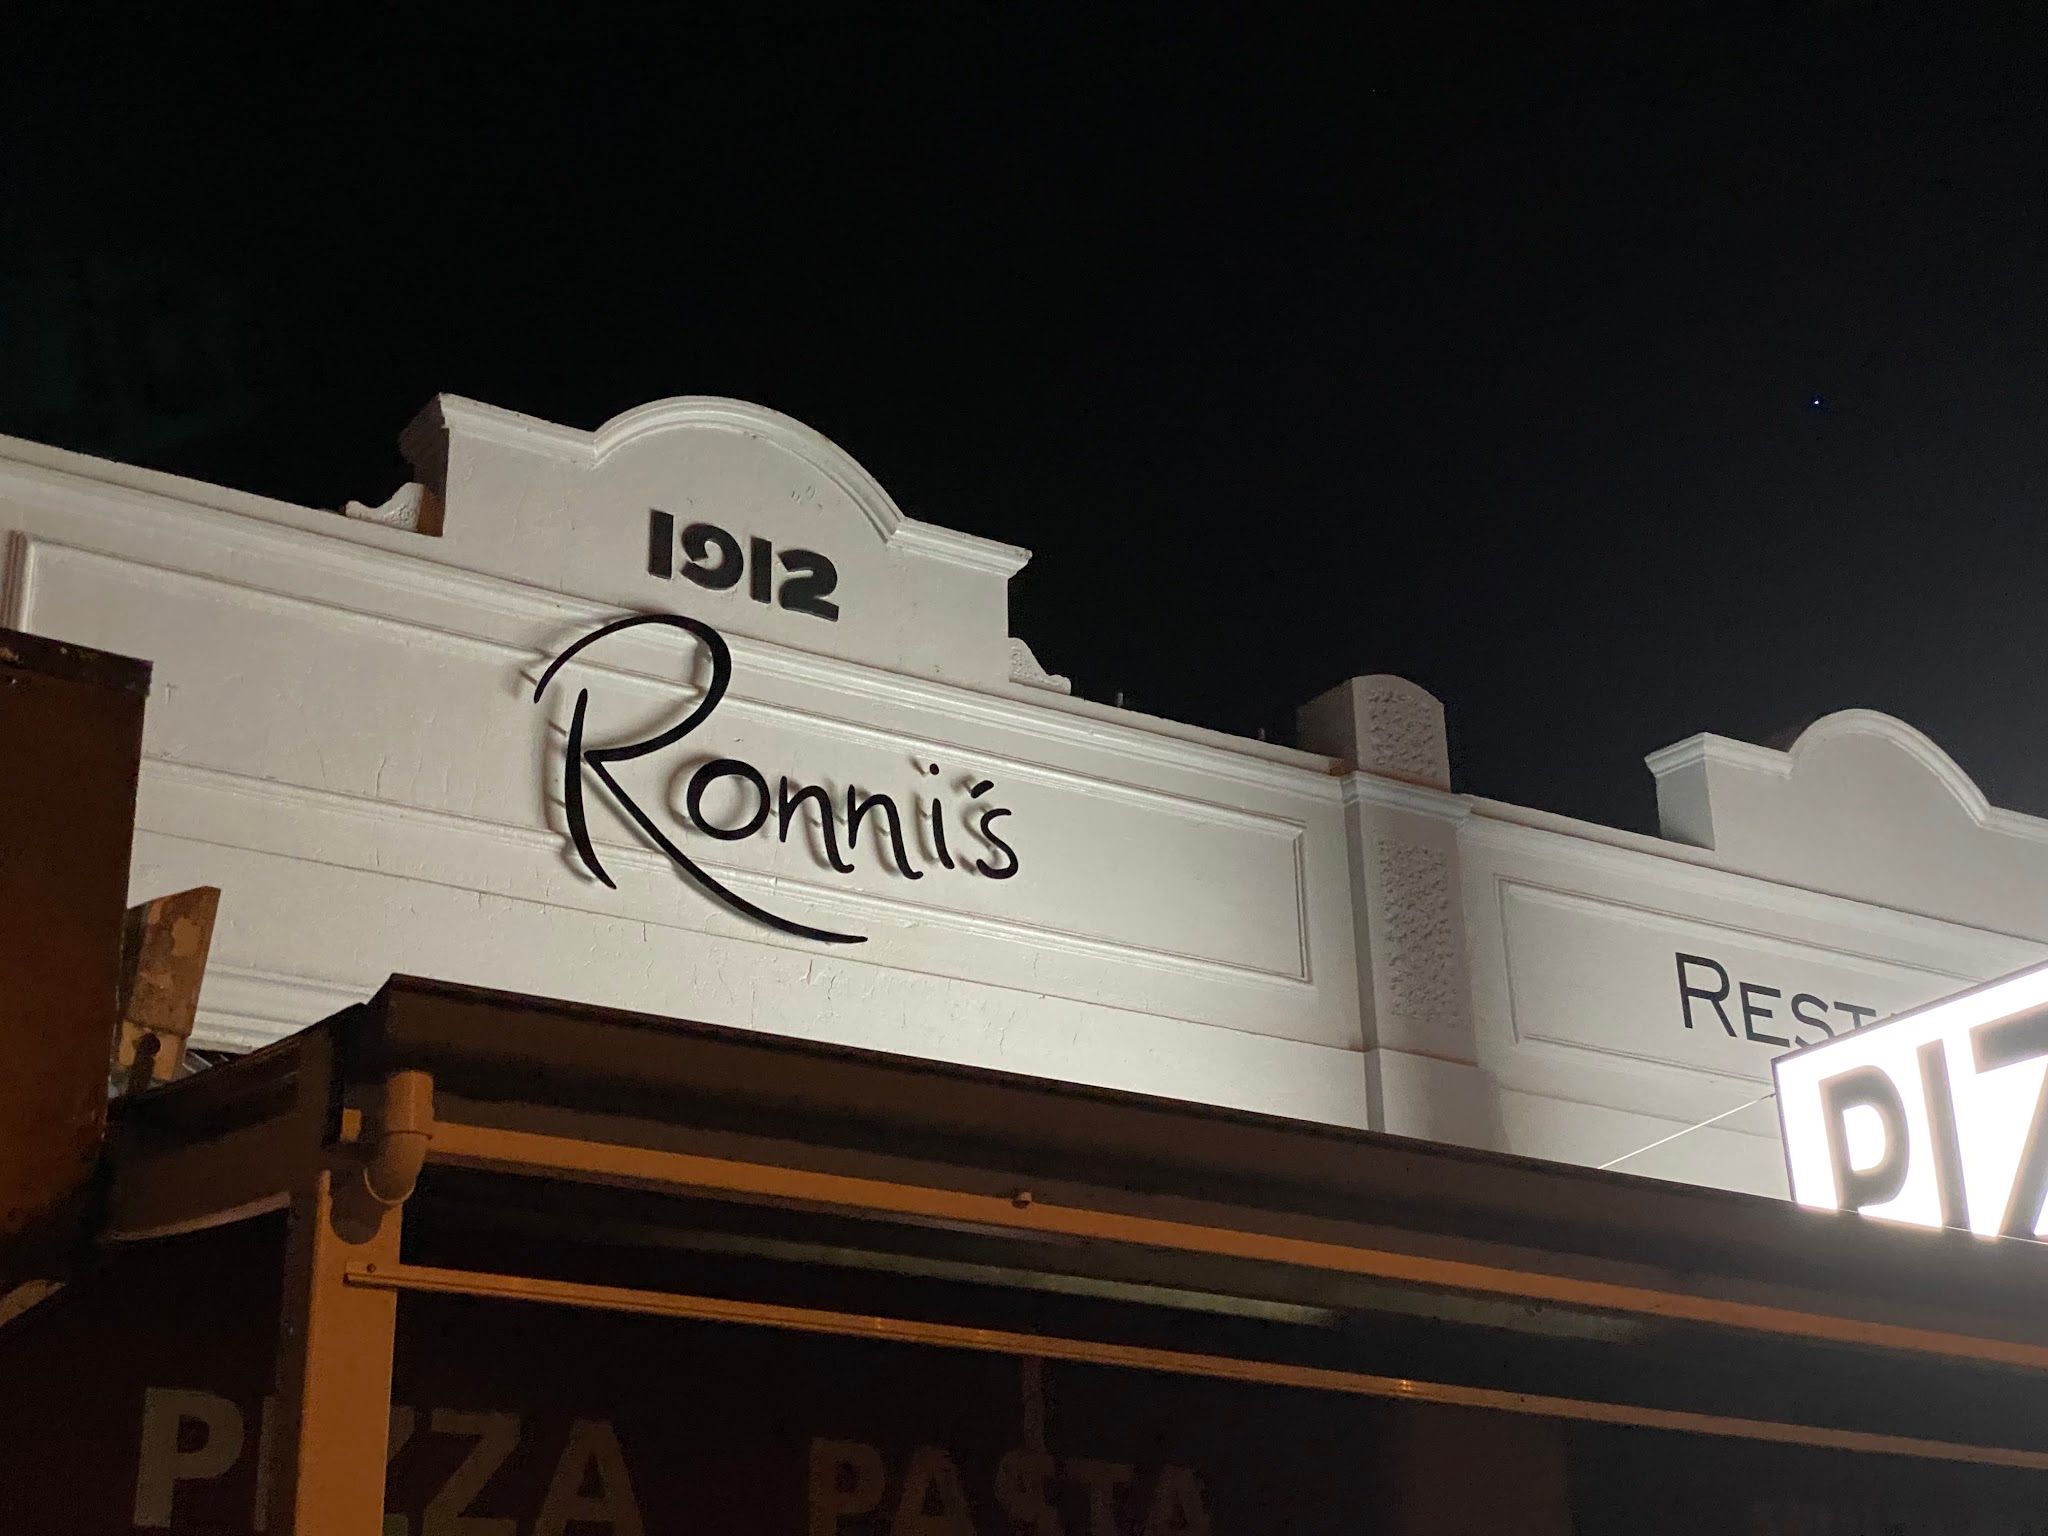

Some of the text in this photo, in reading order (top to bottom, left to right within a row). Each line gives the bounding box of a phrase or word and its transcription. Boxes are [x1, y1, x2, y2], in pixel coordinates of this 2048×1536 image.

[648, 509, 839, 622] 1912
[533, 614, 1019, 944] Ronni's
[807, 1434, 1214, 1536] PASTA
